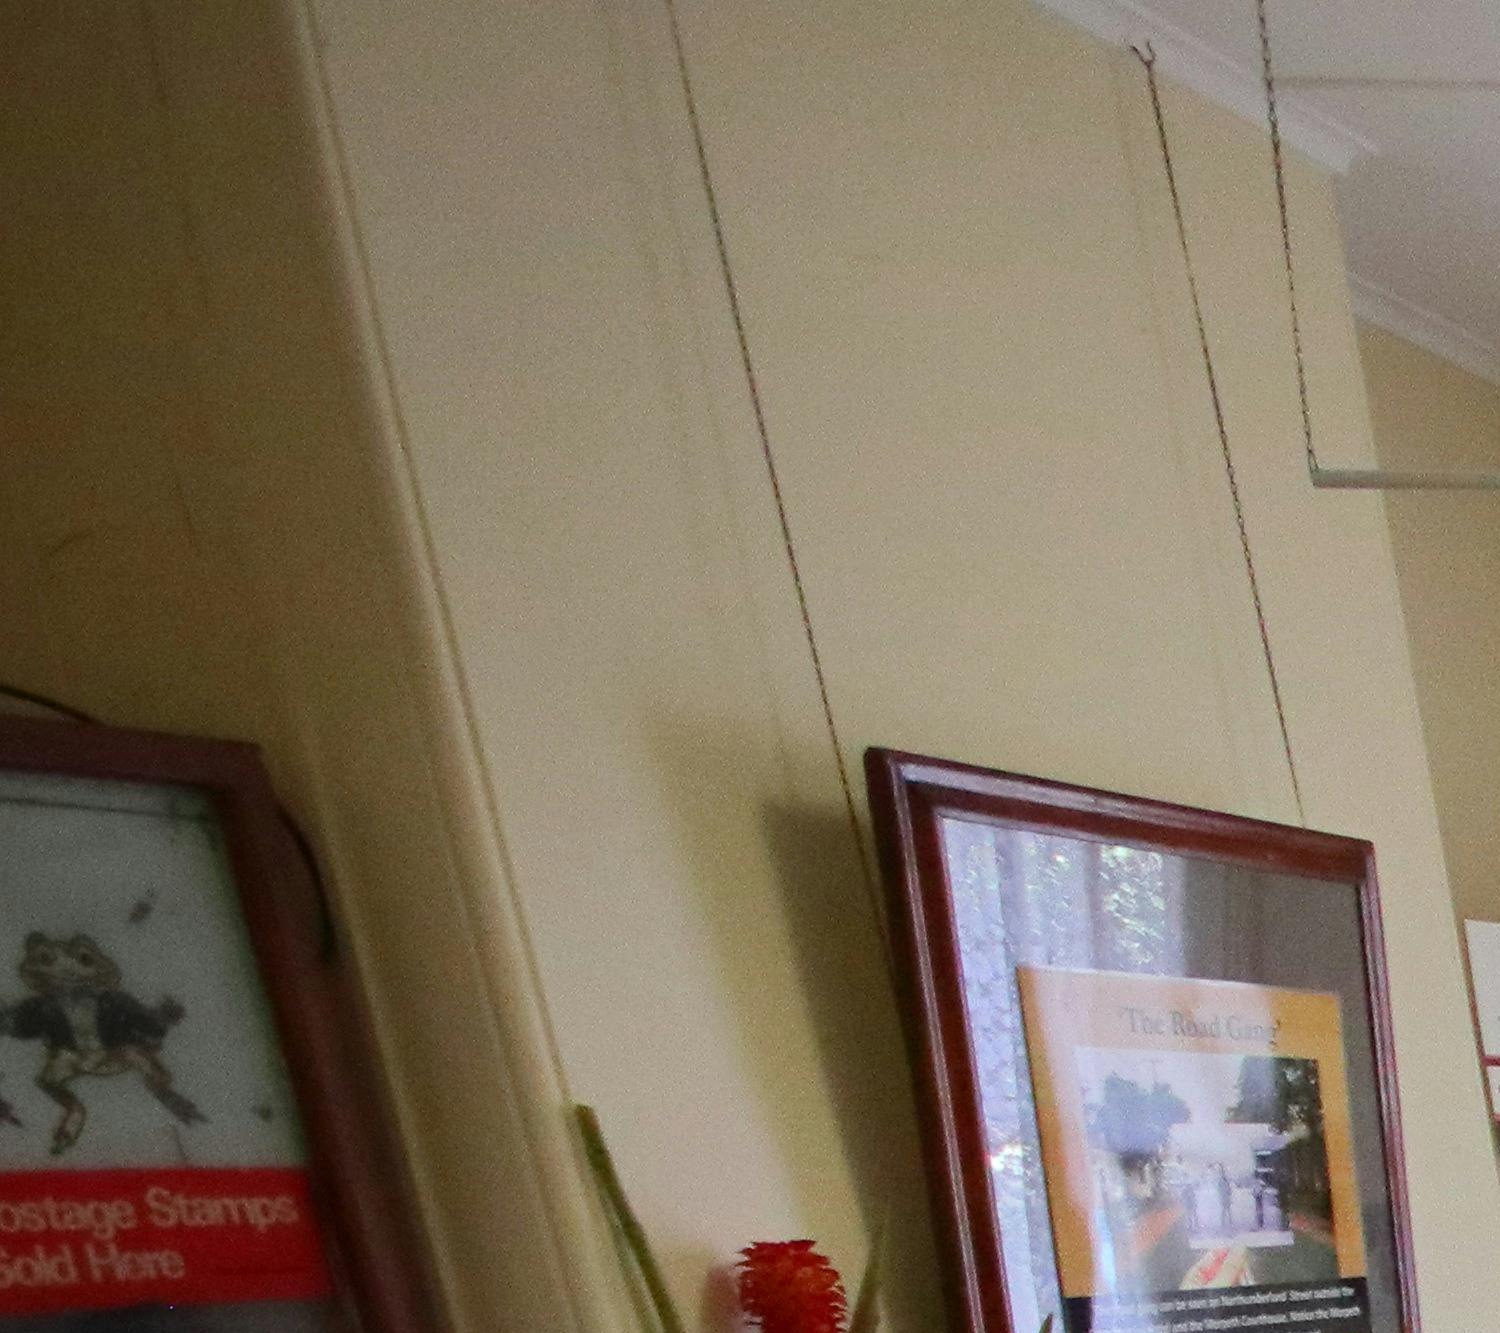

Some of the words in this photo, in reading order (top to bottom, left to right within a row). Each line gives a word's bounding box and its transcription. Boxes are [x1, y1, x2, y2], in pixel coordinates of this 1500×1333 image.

[0, 1198, 137, 1240] ostage
[146, 1186, 299, 1231] Stamps
[84, 1244, 185, 1282] Here
